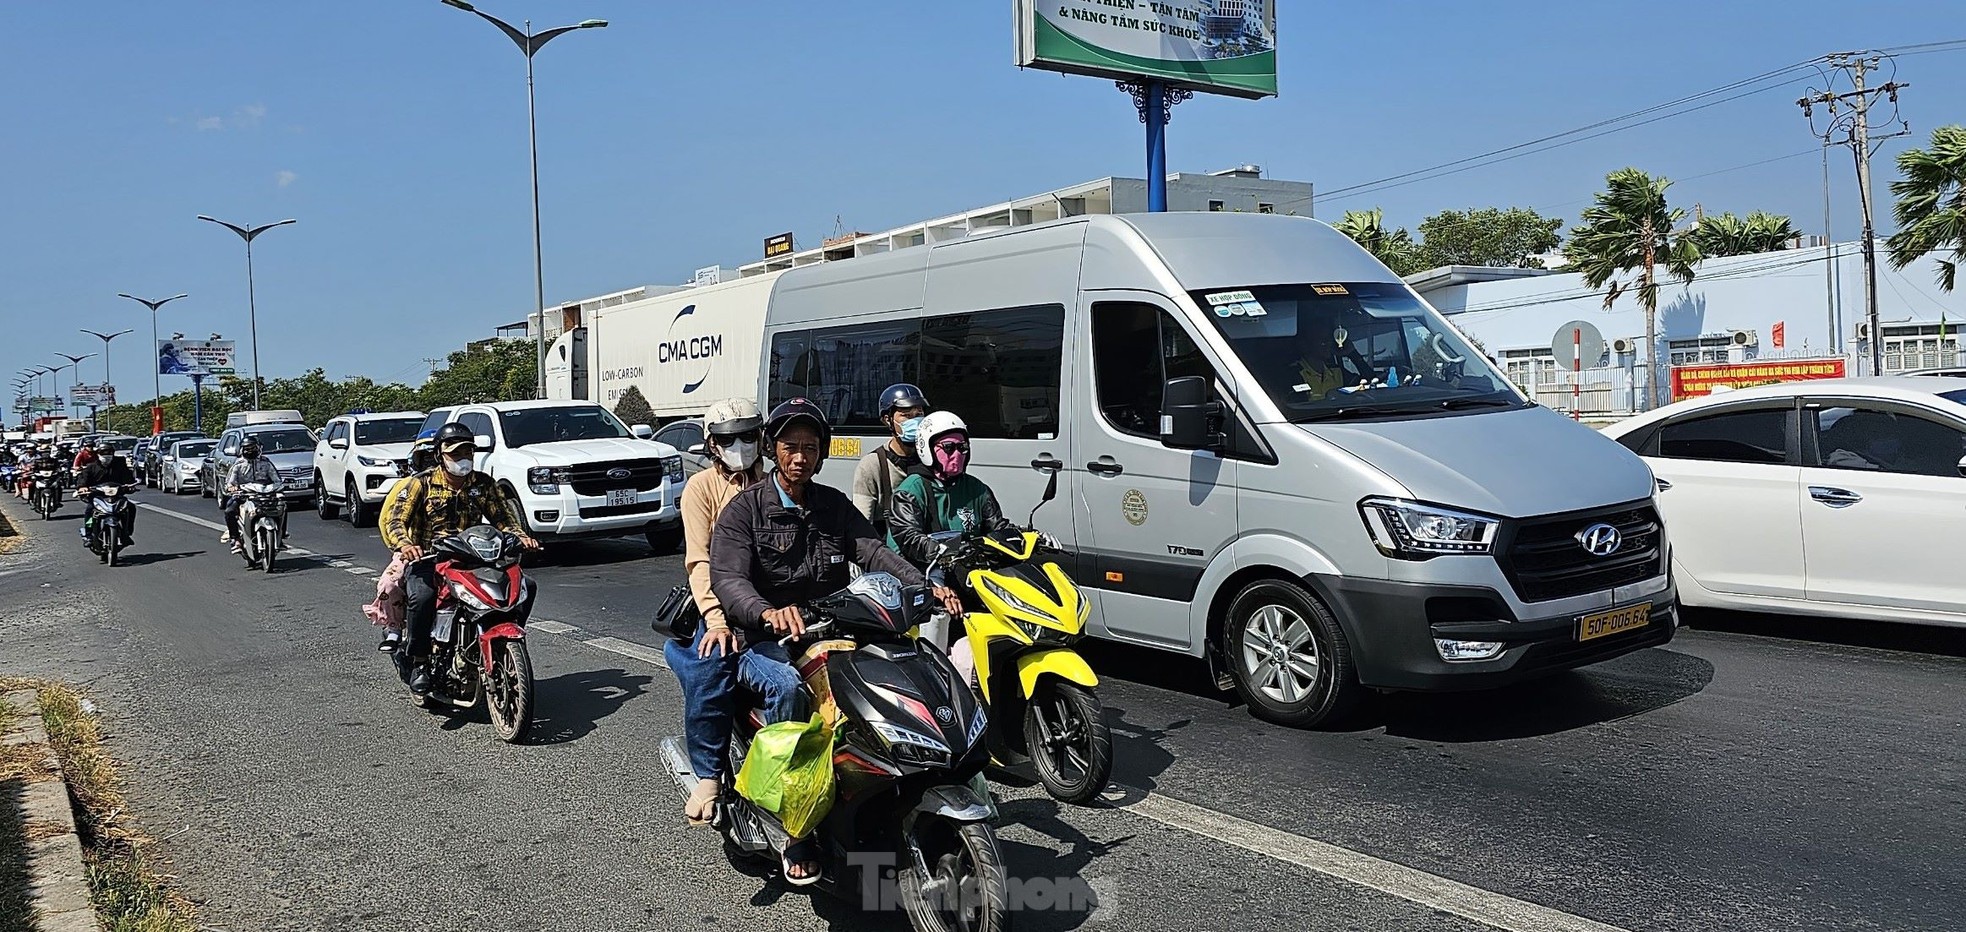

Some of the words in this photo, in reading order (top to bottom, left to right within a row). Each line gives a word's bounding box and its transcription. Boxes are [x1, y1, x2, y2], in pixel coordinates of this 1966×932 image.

[1059, 6, 1069, 18] &
[1071, 8, 1107, 25] NÂNG
[1110, 13, 1140, 30] TẦM
[1143, 19, 1166, 34] SỨC
[1168, 25, 1200, 41] KHỎE
[1150, 1, 1173, 18] TẬN
[1175, 6, 1200, 23] TÂM
[1209, 295, 1220, 303] XE
[659, 340, 688, 363] CMA
[690, 334, 722, 359] CGM
[602, 366, 644, 381] LOW-CARBON
[1587, 608, 1647, 635] 50F-006.64
